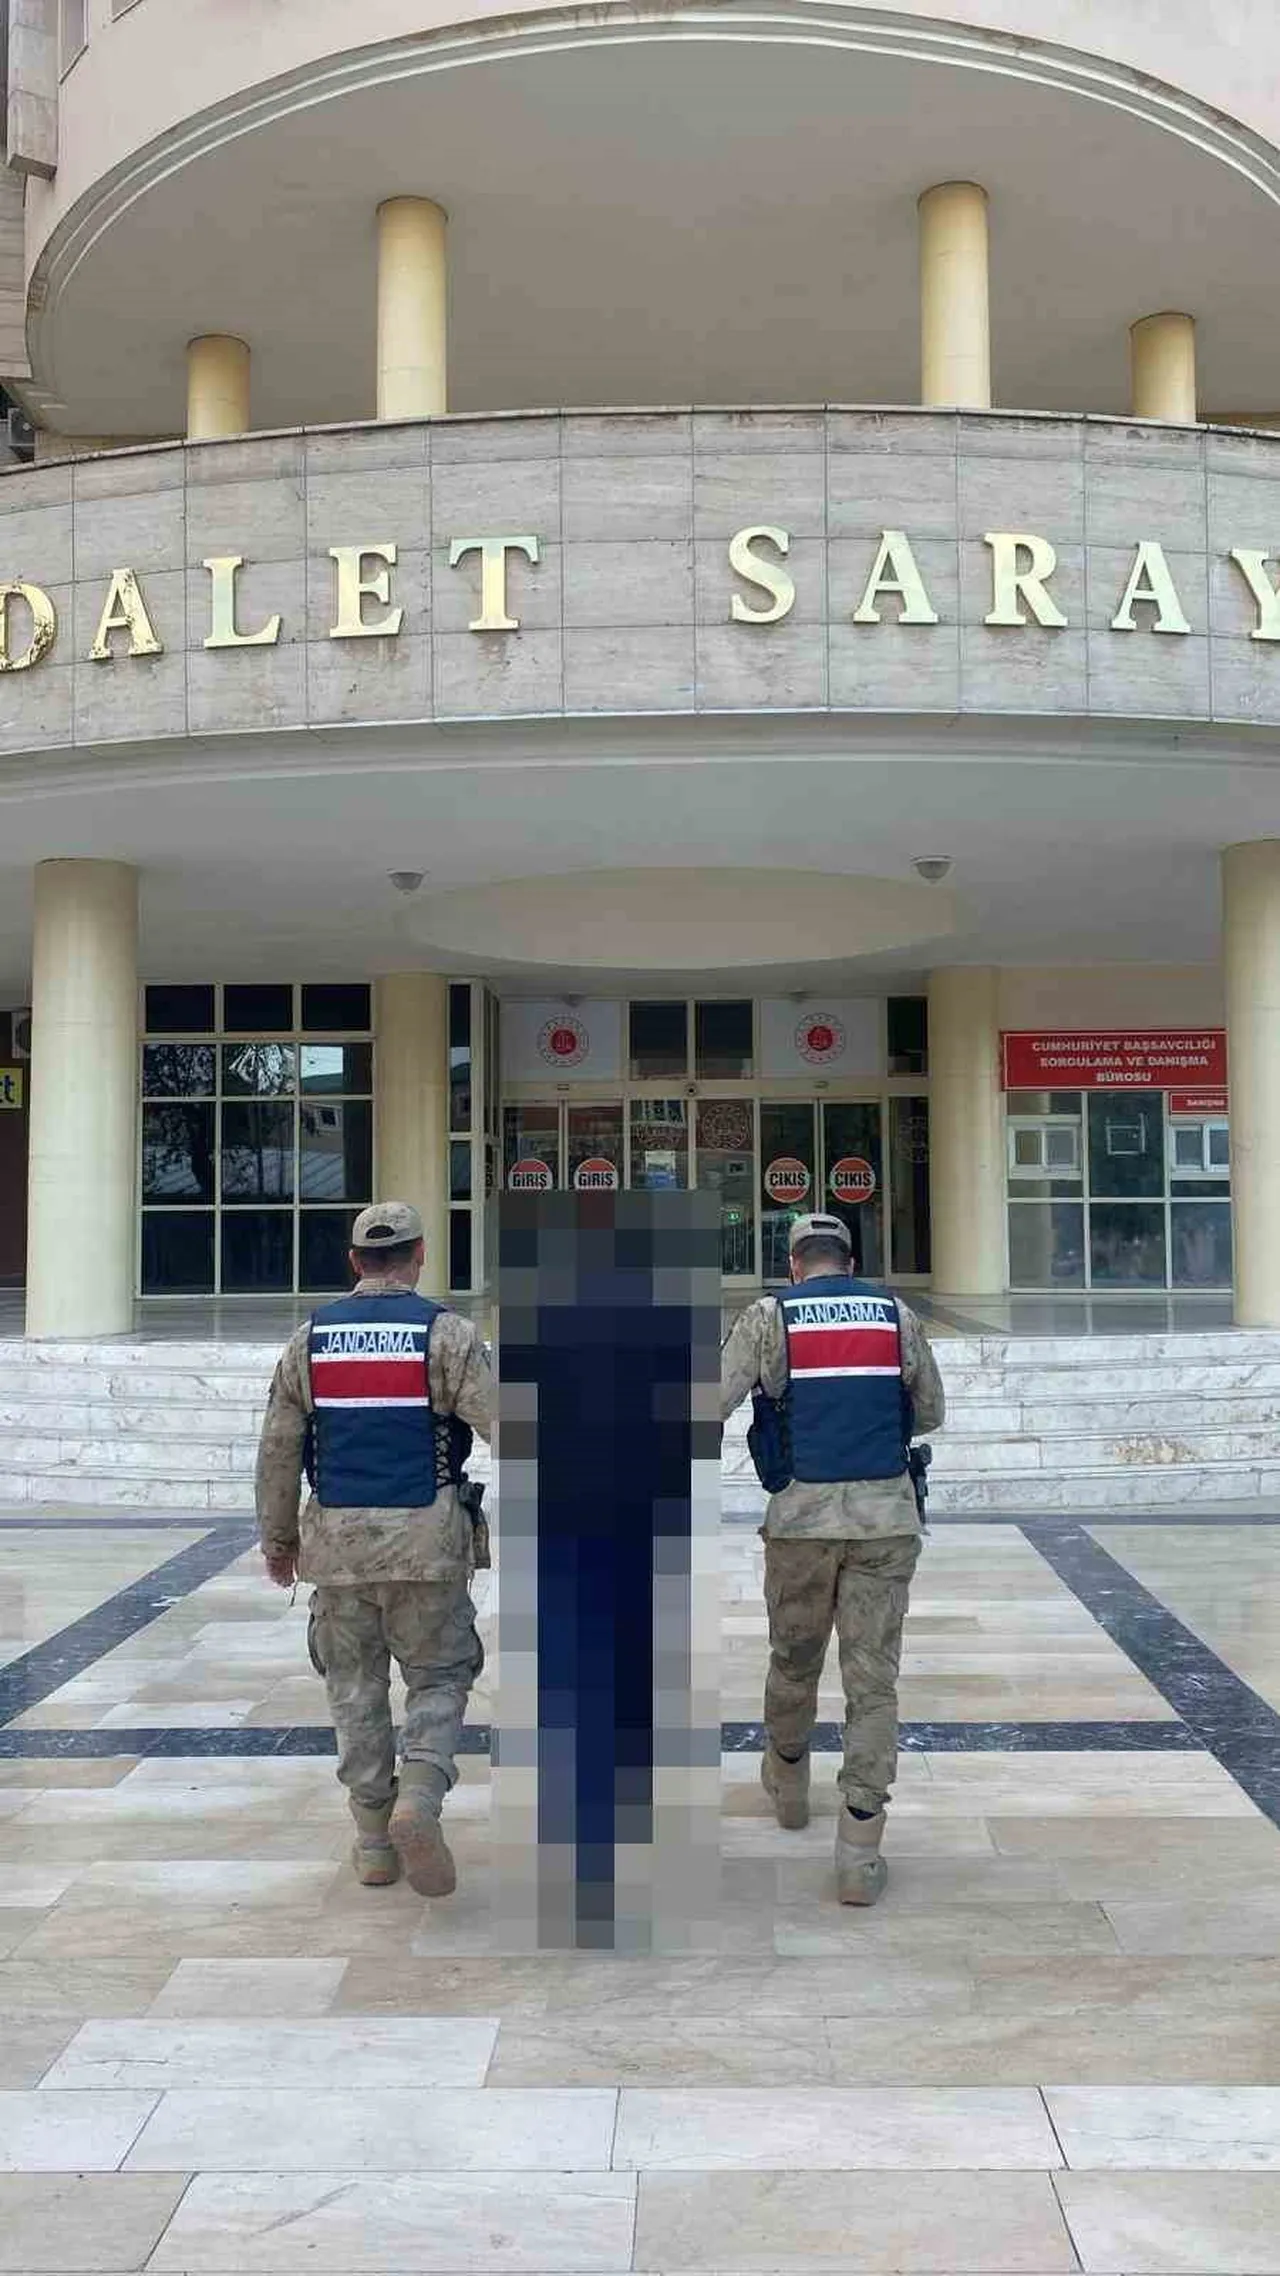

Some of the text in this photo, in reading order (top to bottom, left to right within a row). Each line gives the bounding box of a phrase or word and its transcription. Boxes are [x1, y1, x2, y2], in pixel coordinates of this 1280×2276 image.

[1040, 1056, 1122, 1067] SORGULAMA
[1127, 1056, 1145, 1066] VE
[1096, 1071, 1151, 1082] BÜROSU
[794, 1303, 888, 1323] JANDARMA
[321, 1331, 416, 1353] JANDARMA
